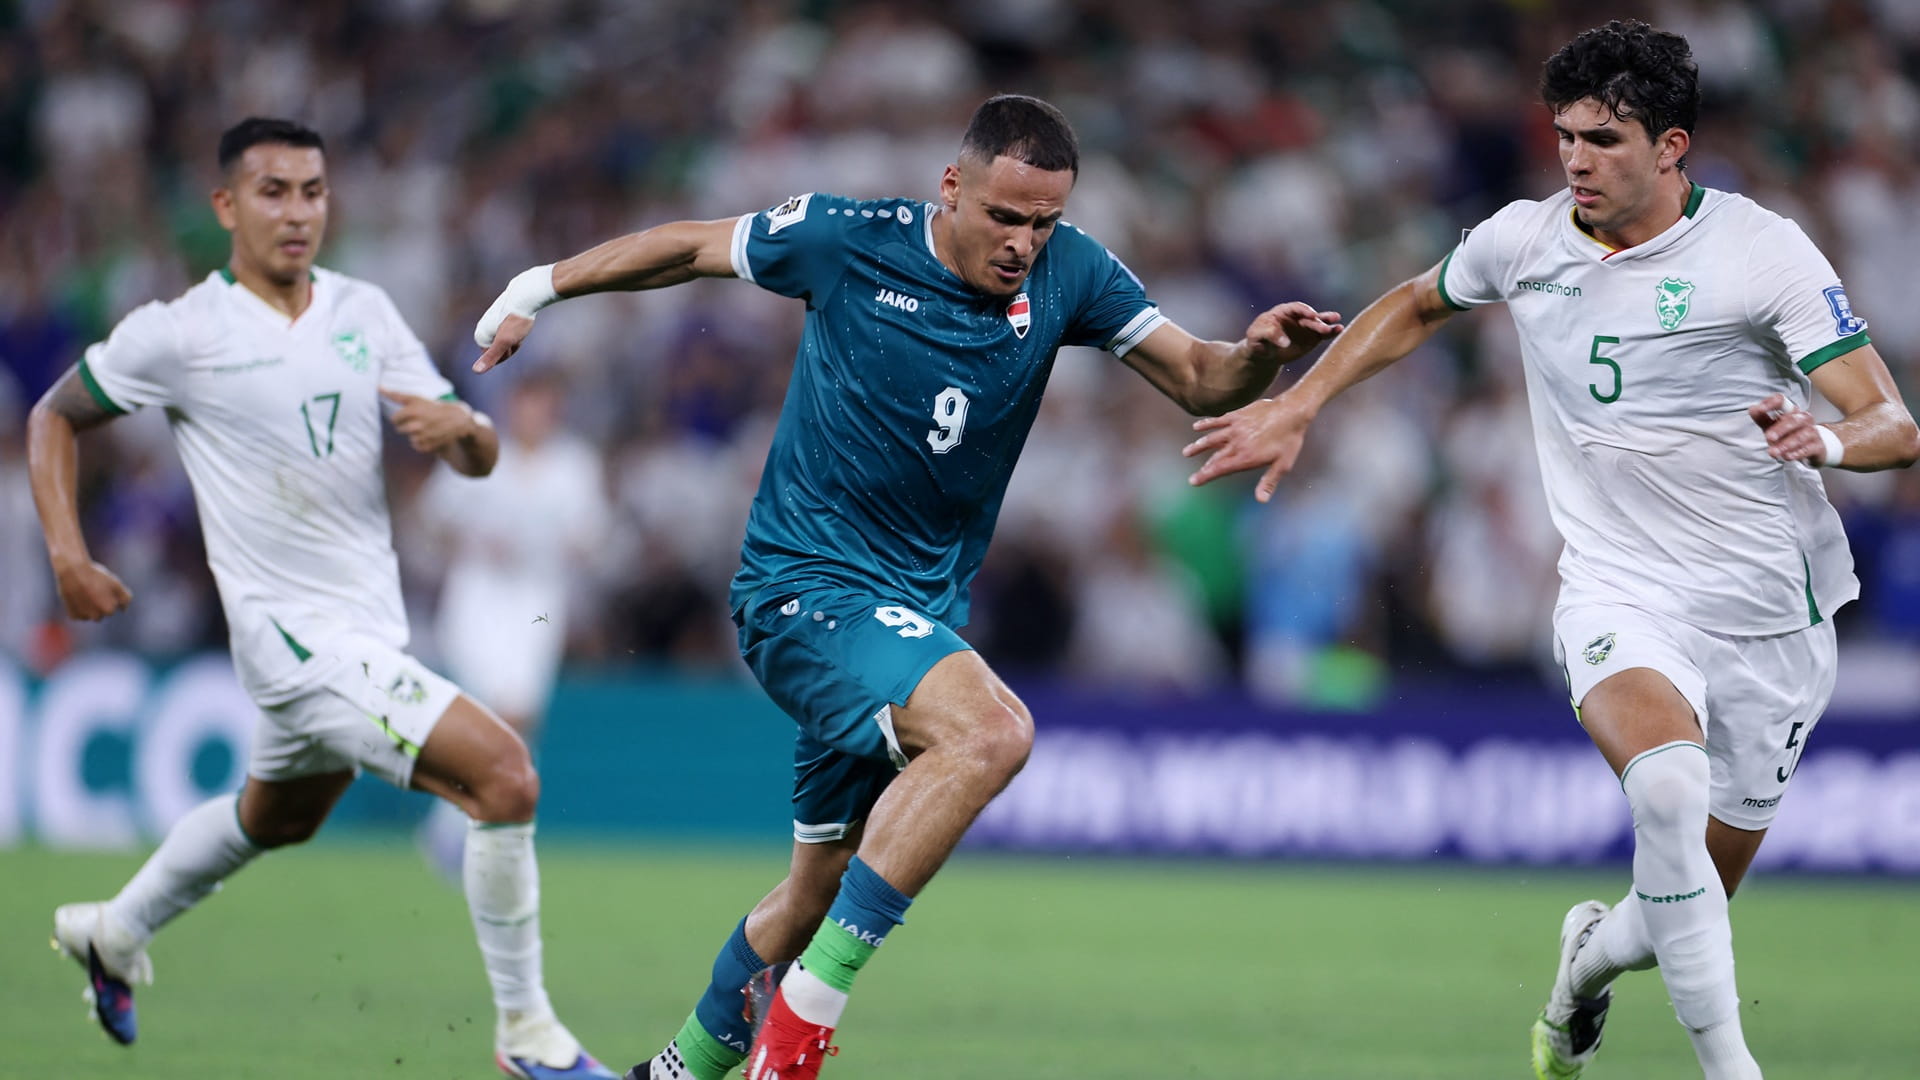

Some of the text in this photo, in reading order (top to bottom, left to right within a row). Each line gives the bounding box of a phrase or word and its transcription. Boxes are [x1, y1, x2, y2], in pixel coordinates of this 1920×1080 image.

[875, 288, 918, 313] JAKO
[1517, 280, 1582, 297] marathon
[1589, 335, 1622, 404] 5
[301, 392, 341, 457] 17
[926, 386, 970, 454] 9
[874, 605, 936, 639] 9
[1777, 721, 1804, 784] 5
